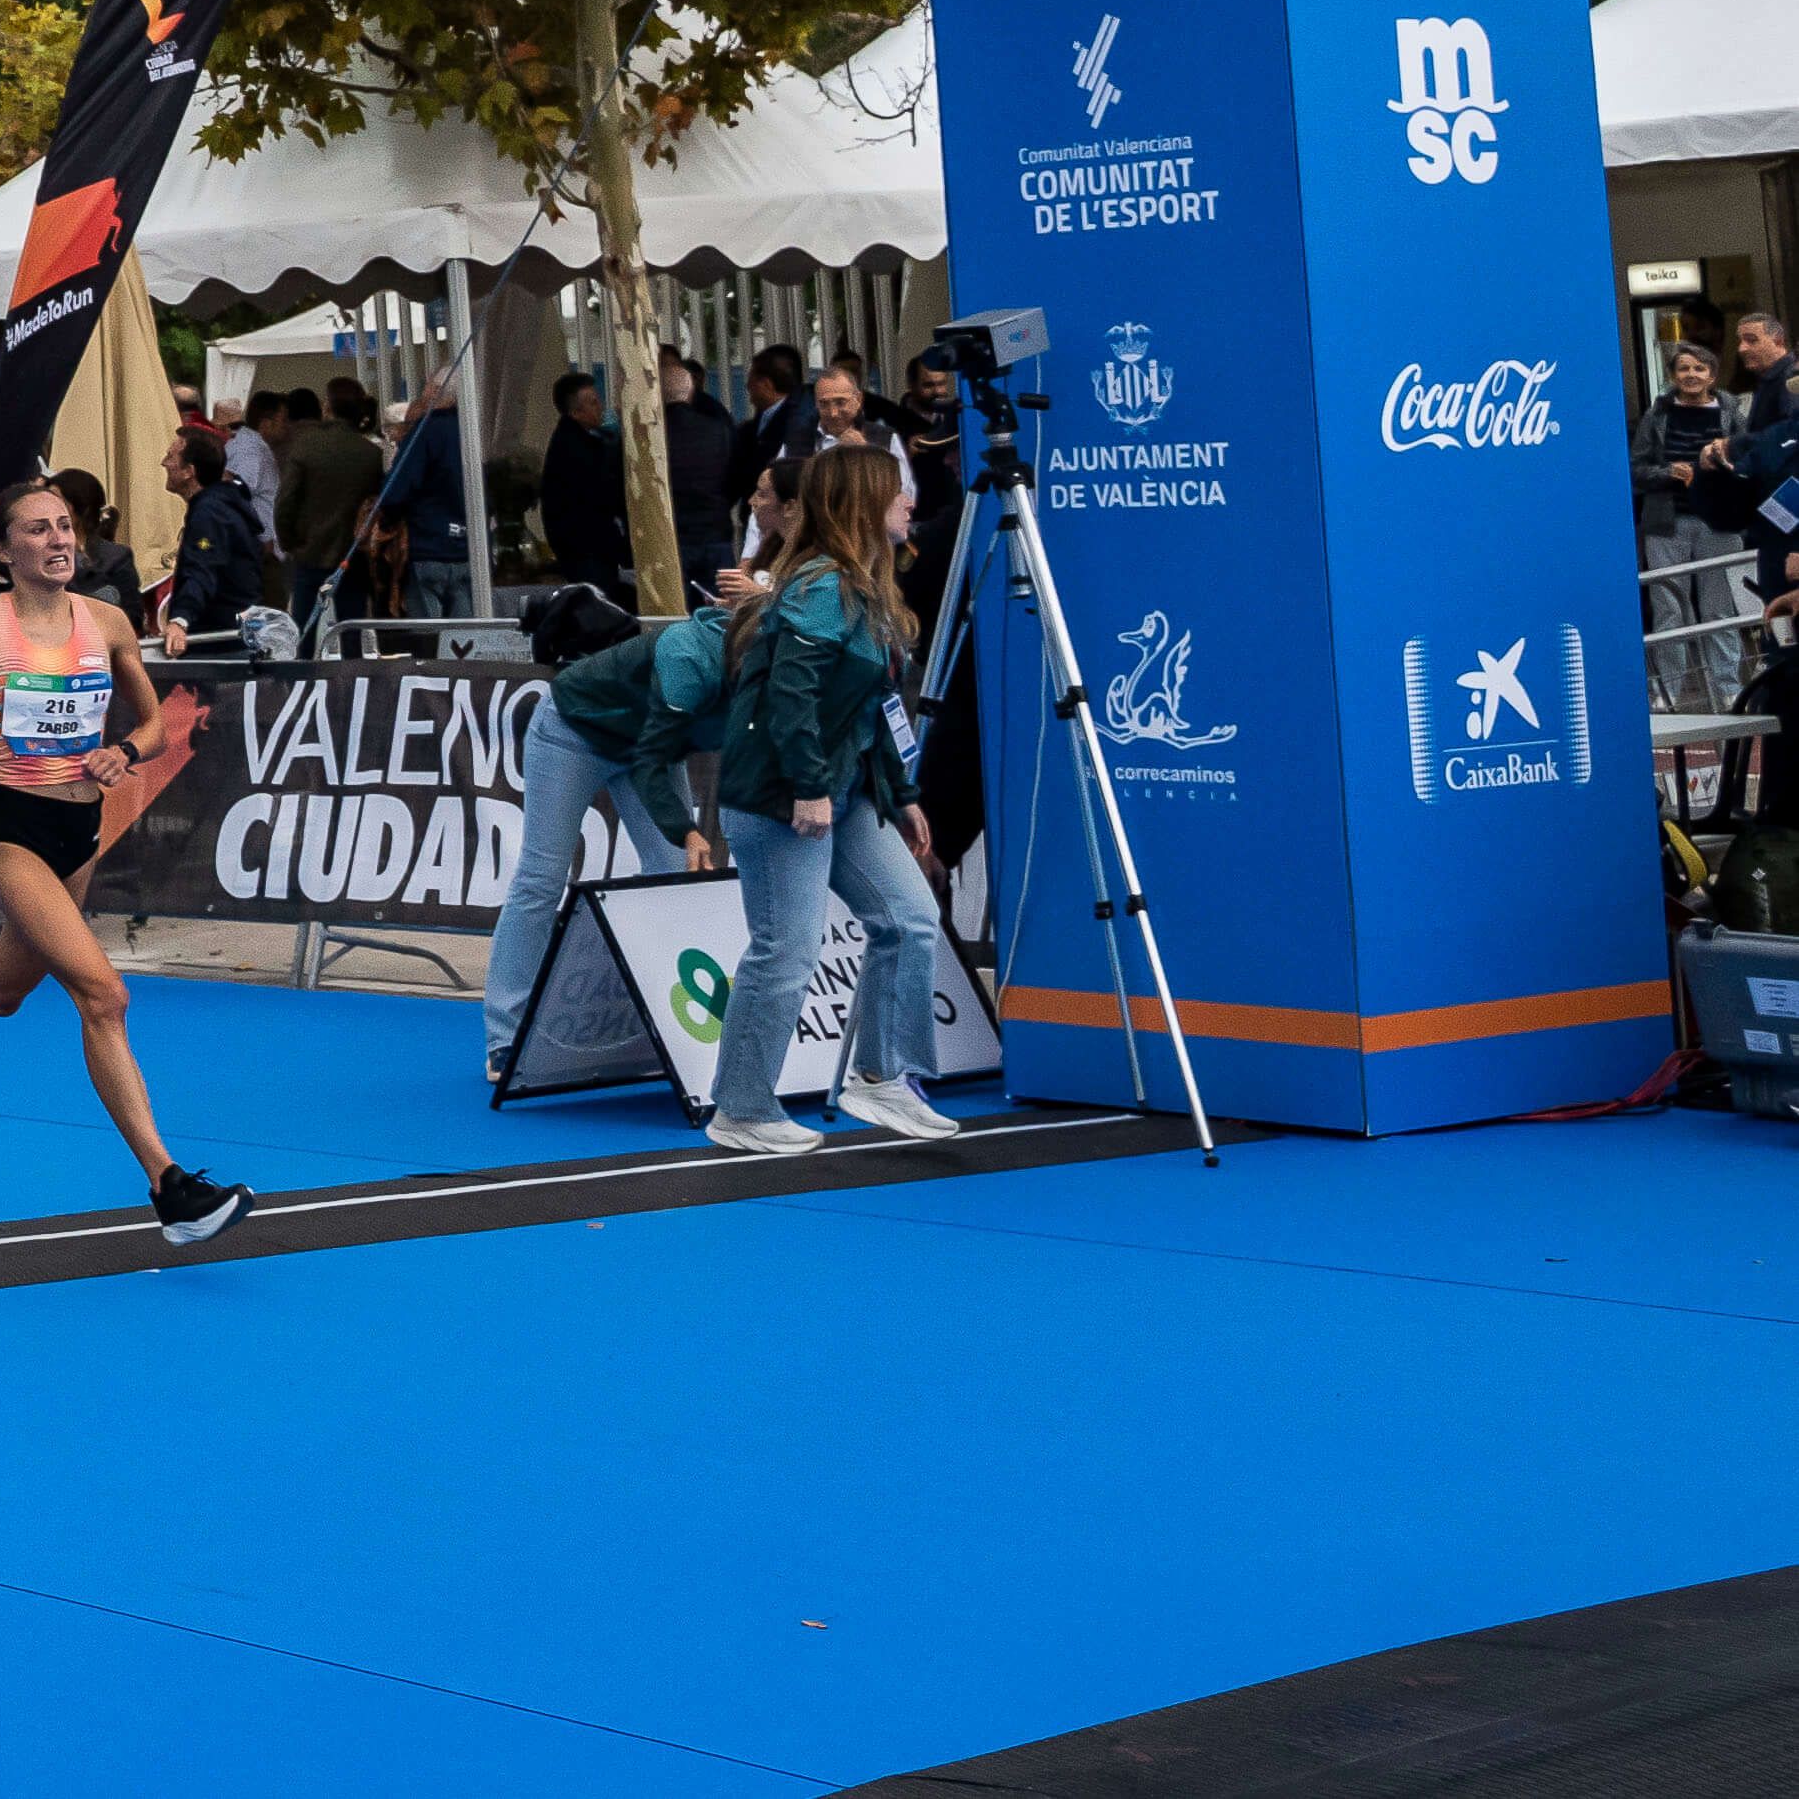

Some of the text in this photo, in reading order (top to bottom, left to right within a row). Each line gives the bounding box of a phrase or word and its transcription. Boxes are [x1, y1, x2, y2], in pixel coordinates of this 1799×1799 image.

[1018, 134, 1193, 166] Comunitat Valenciana
[1020, 156, 1195, 202] COMUNITAT
[1034, 202, 1072, 235] DE
[5, 284, 94, 352] #MadeToRun
[1381, 360, 1559, 452] Coca-Cola
[1049, 442, 1229, 472] AJUNTAMENT
[1051, 476, 1227, 509] DE VALÈNCIA
[45, 699, 76, 714] 216
[1114, 765, 1236, 785] correcaminos
[1445, 748, 1560, 791] CaixaBank
[1123, 788, 1239, 801] LENCIA
